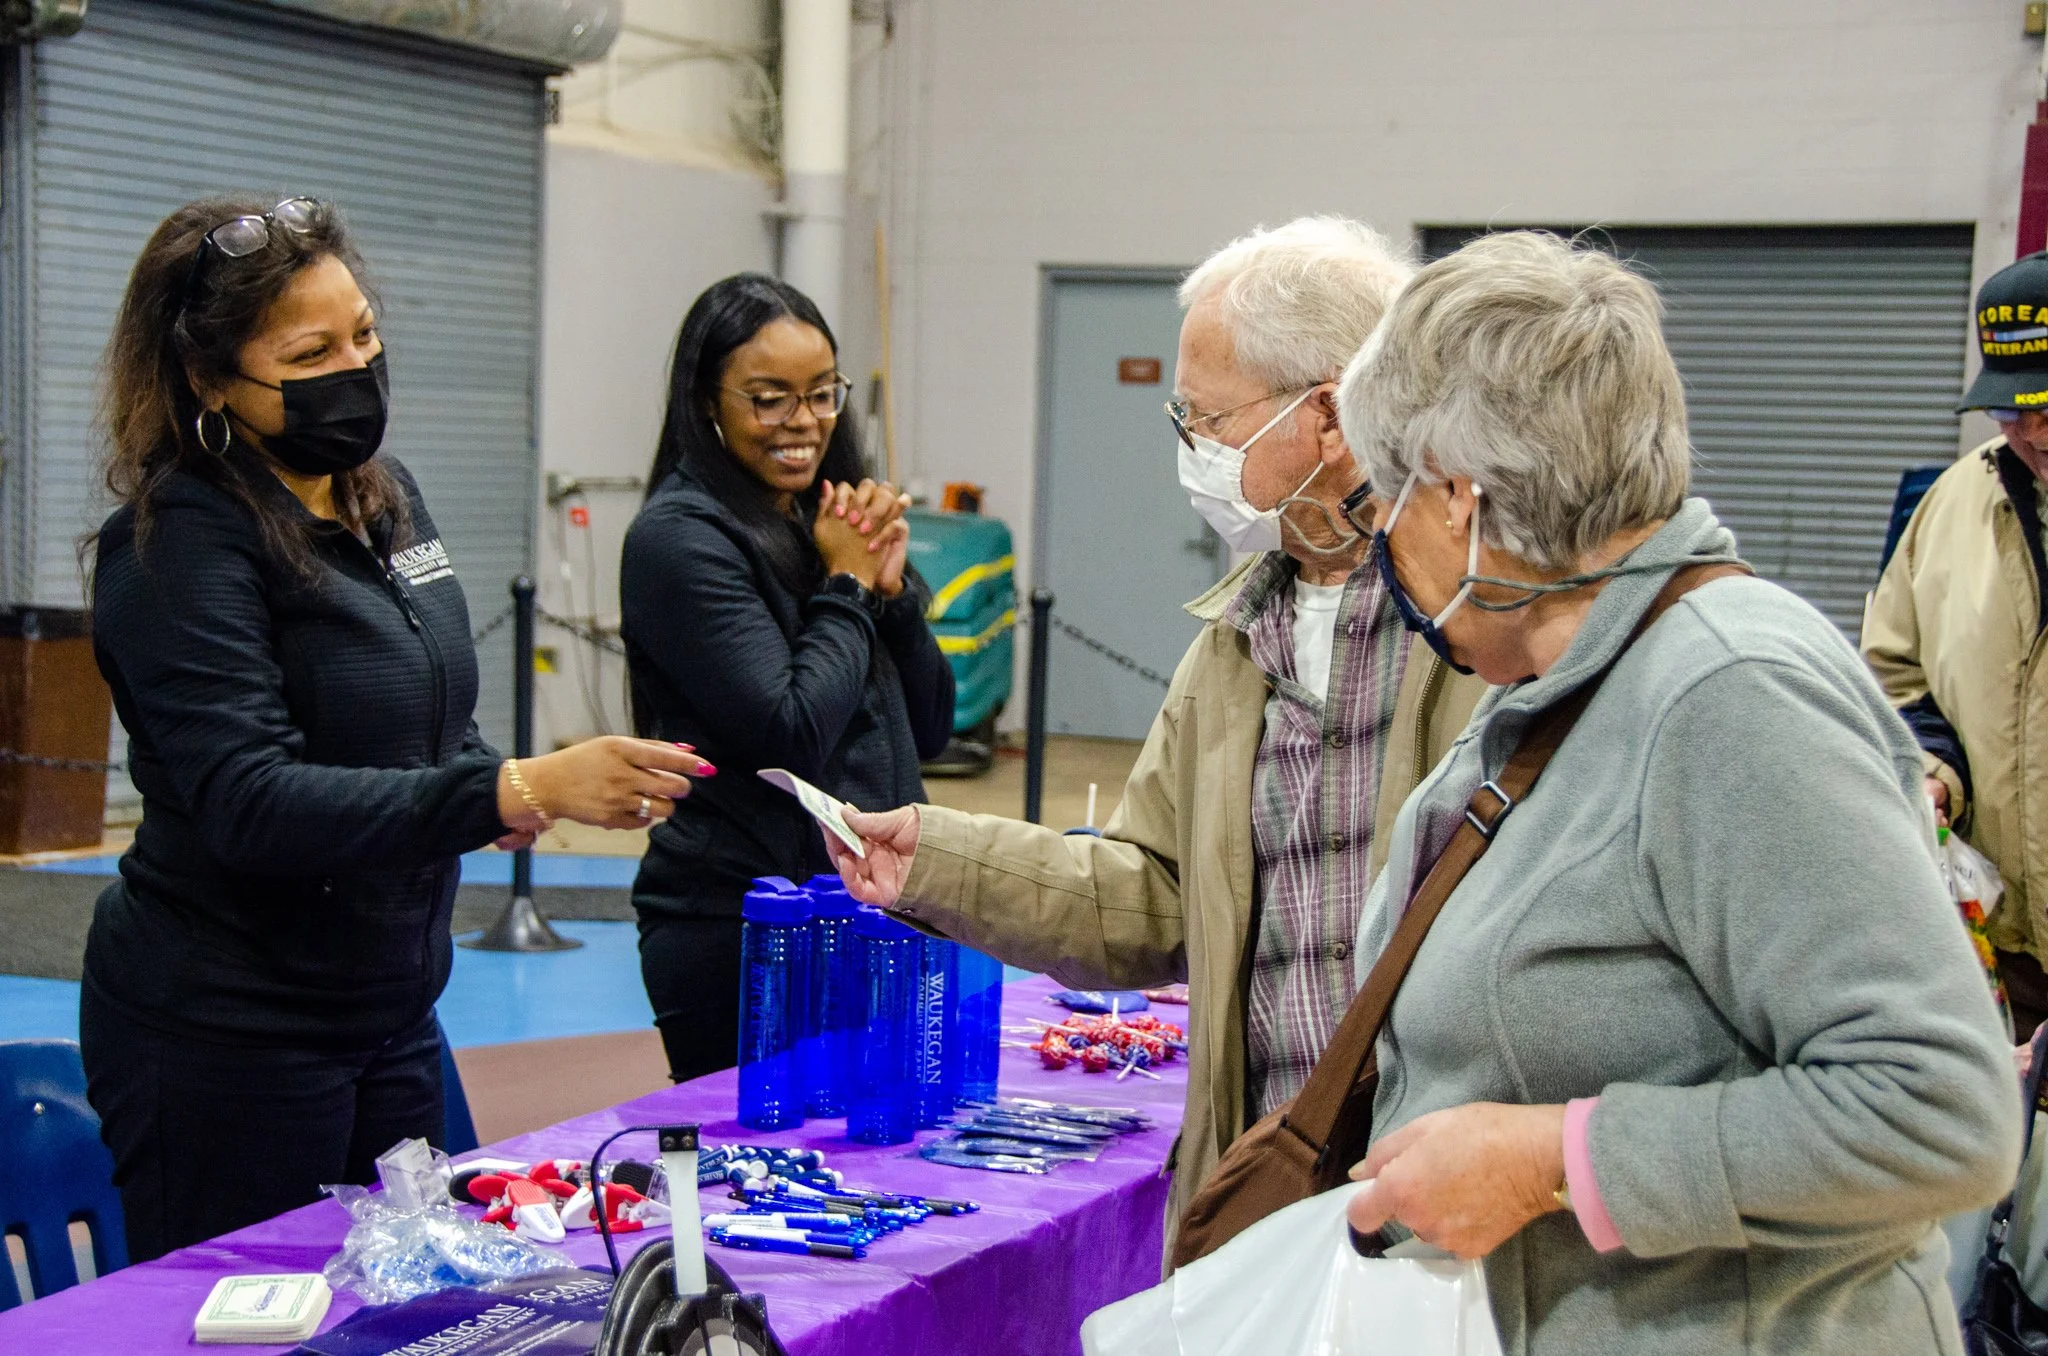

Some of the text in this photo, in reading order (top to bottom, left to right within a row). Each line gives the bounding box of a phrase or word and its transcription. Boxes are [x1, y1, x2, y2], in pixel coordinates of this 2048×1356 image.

[2014, 390, 2048, 405] KOR
[390, 538, 446, 568] WAUKEGAN
[927, 971, 944, 1084] WAUKEGAN
